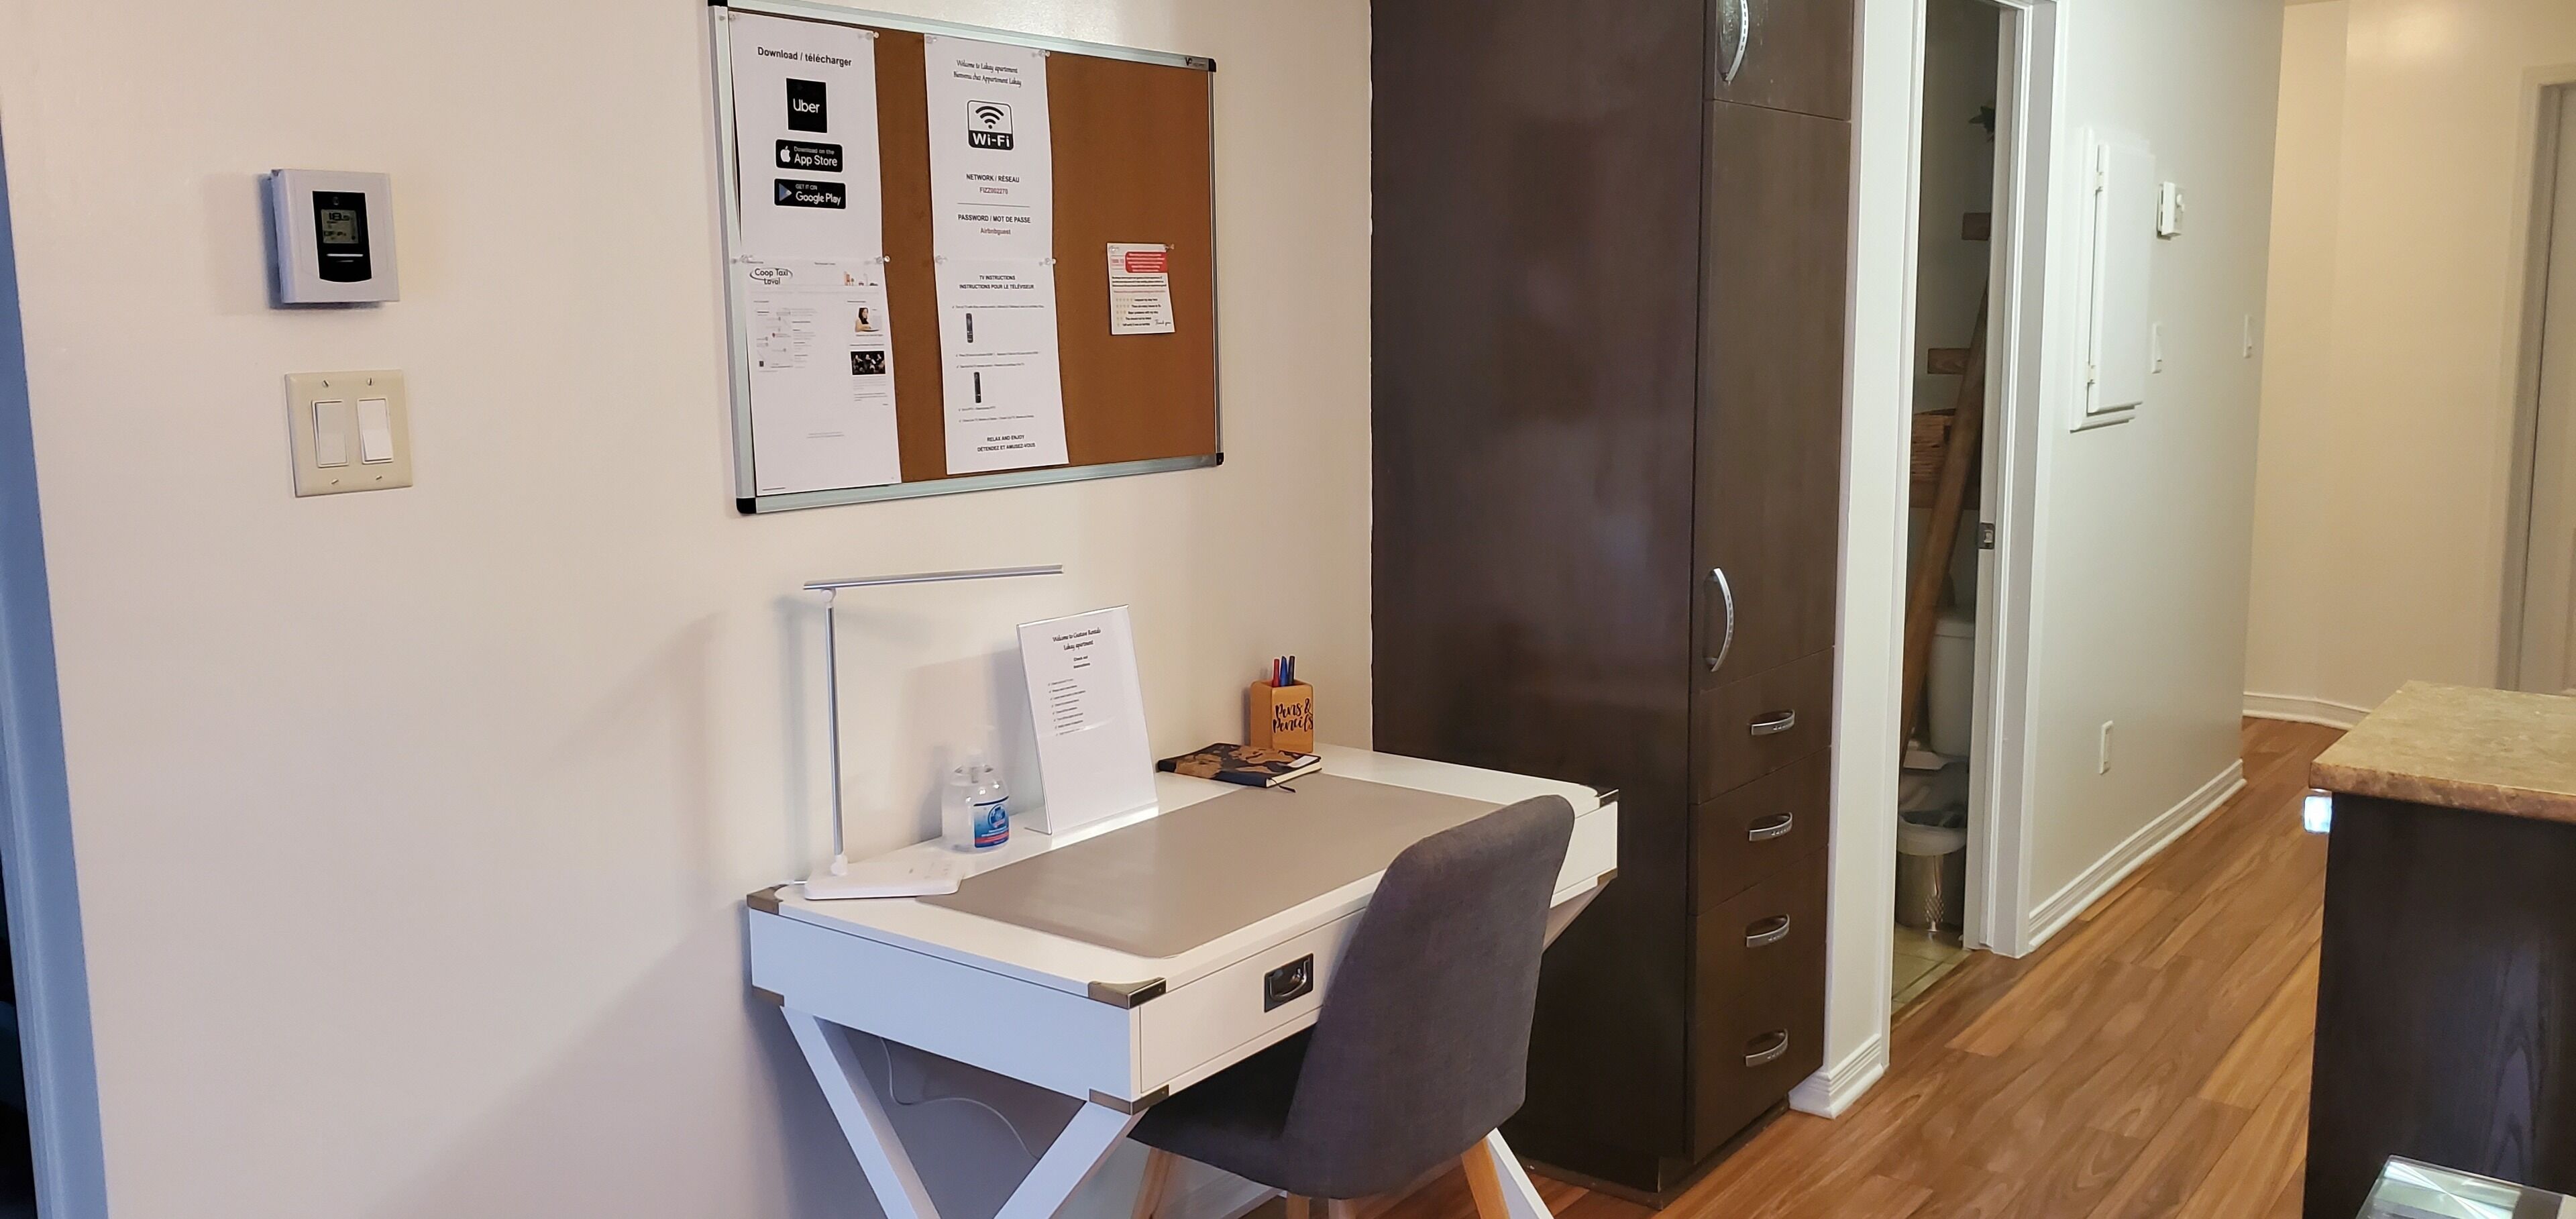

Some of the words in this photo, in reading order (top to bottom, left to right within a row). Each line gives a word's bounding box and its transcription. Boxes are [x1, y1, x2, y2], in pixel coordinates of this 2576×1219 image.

[757, 46, 798, 60] Download
[800, 52, 803, 61] /
[805, 52, 852, 68] télécharger
[792, 97, 820, 113] Uber
[972, 132, 1010, 148] Wi-Fi
[794, 153, 812, 167] App
[814, 154, 838, 167] Store
[966, 173, 994, 182] NETWORK
[796, 191, 824, 205] Google
[825, 193, 841, 207] Play
[958, 213, 989, 222] PASSWORD
[755, 268, 774, 278] Coop
[775, 268, 789, 276] Taxi
[1275, 703, 1303, 720] Pens
[1304, 698, 1313, 717] &
[1273, 714, 1313, 733] Pencils
